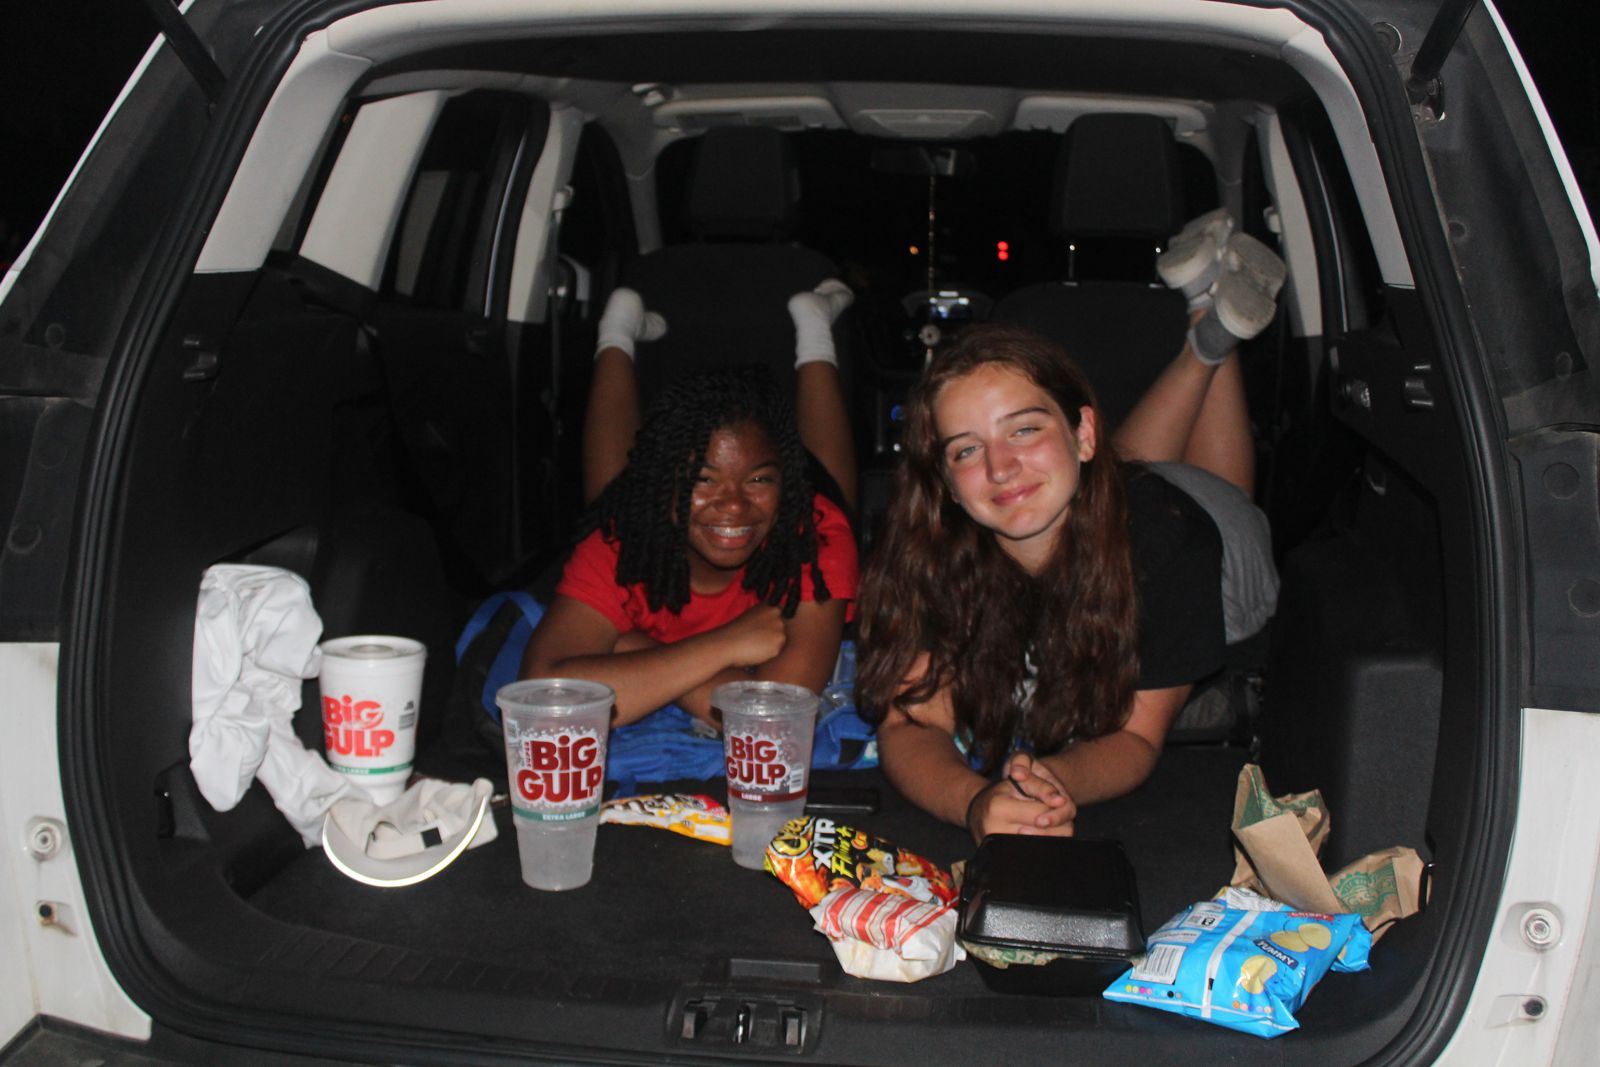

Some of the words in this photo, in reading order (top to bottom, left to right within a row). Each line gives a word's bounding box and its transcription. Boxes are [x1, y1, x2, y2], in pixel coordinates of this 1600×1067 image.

[517, 765, 602, 803] GULP
[727, 755, 786, 785] GULP
[1257, 940, 1296, 966] YUMMY
